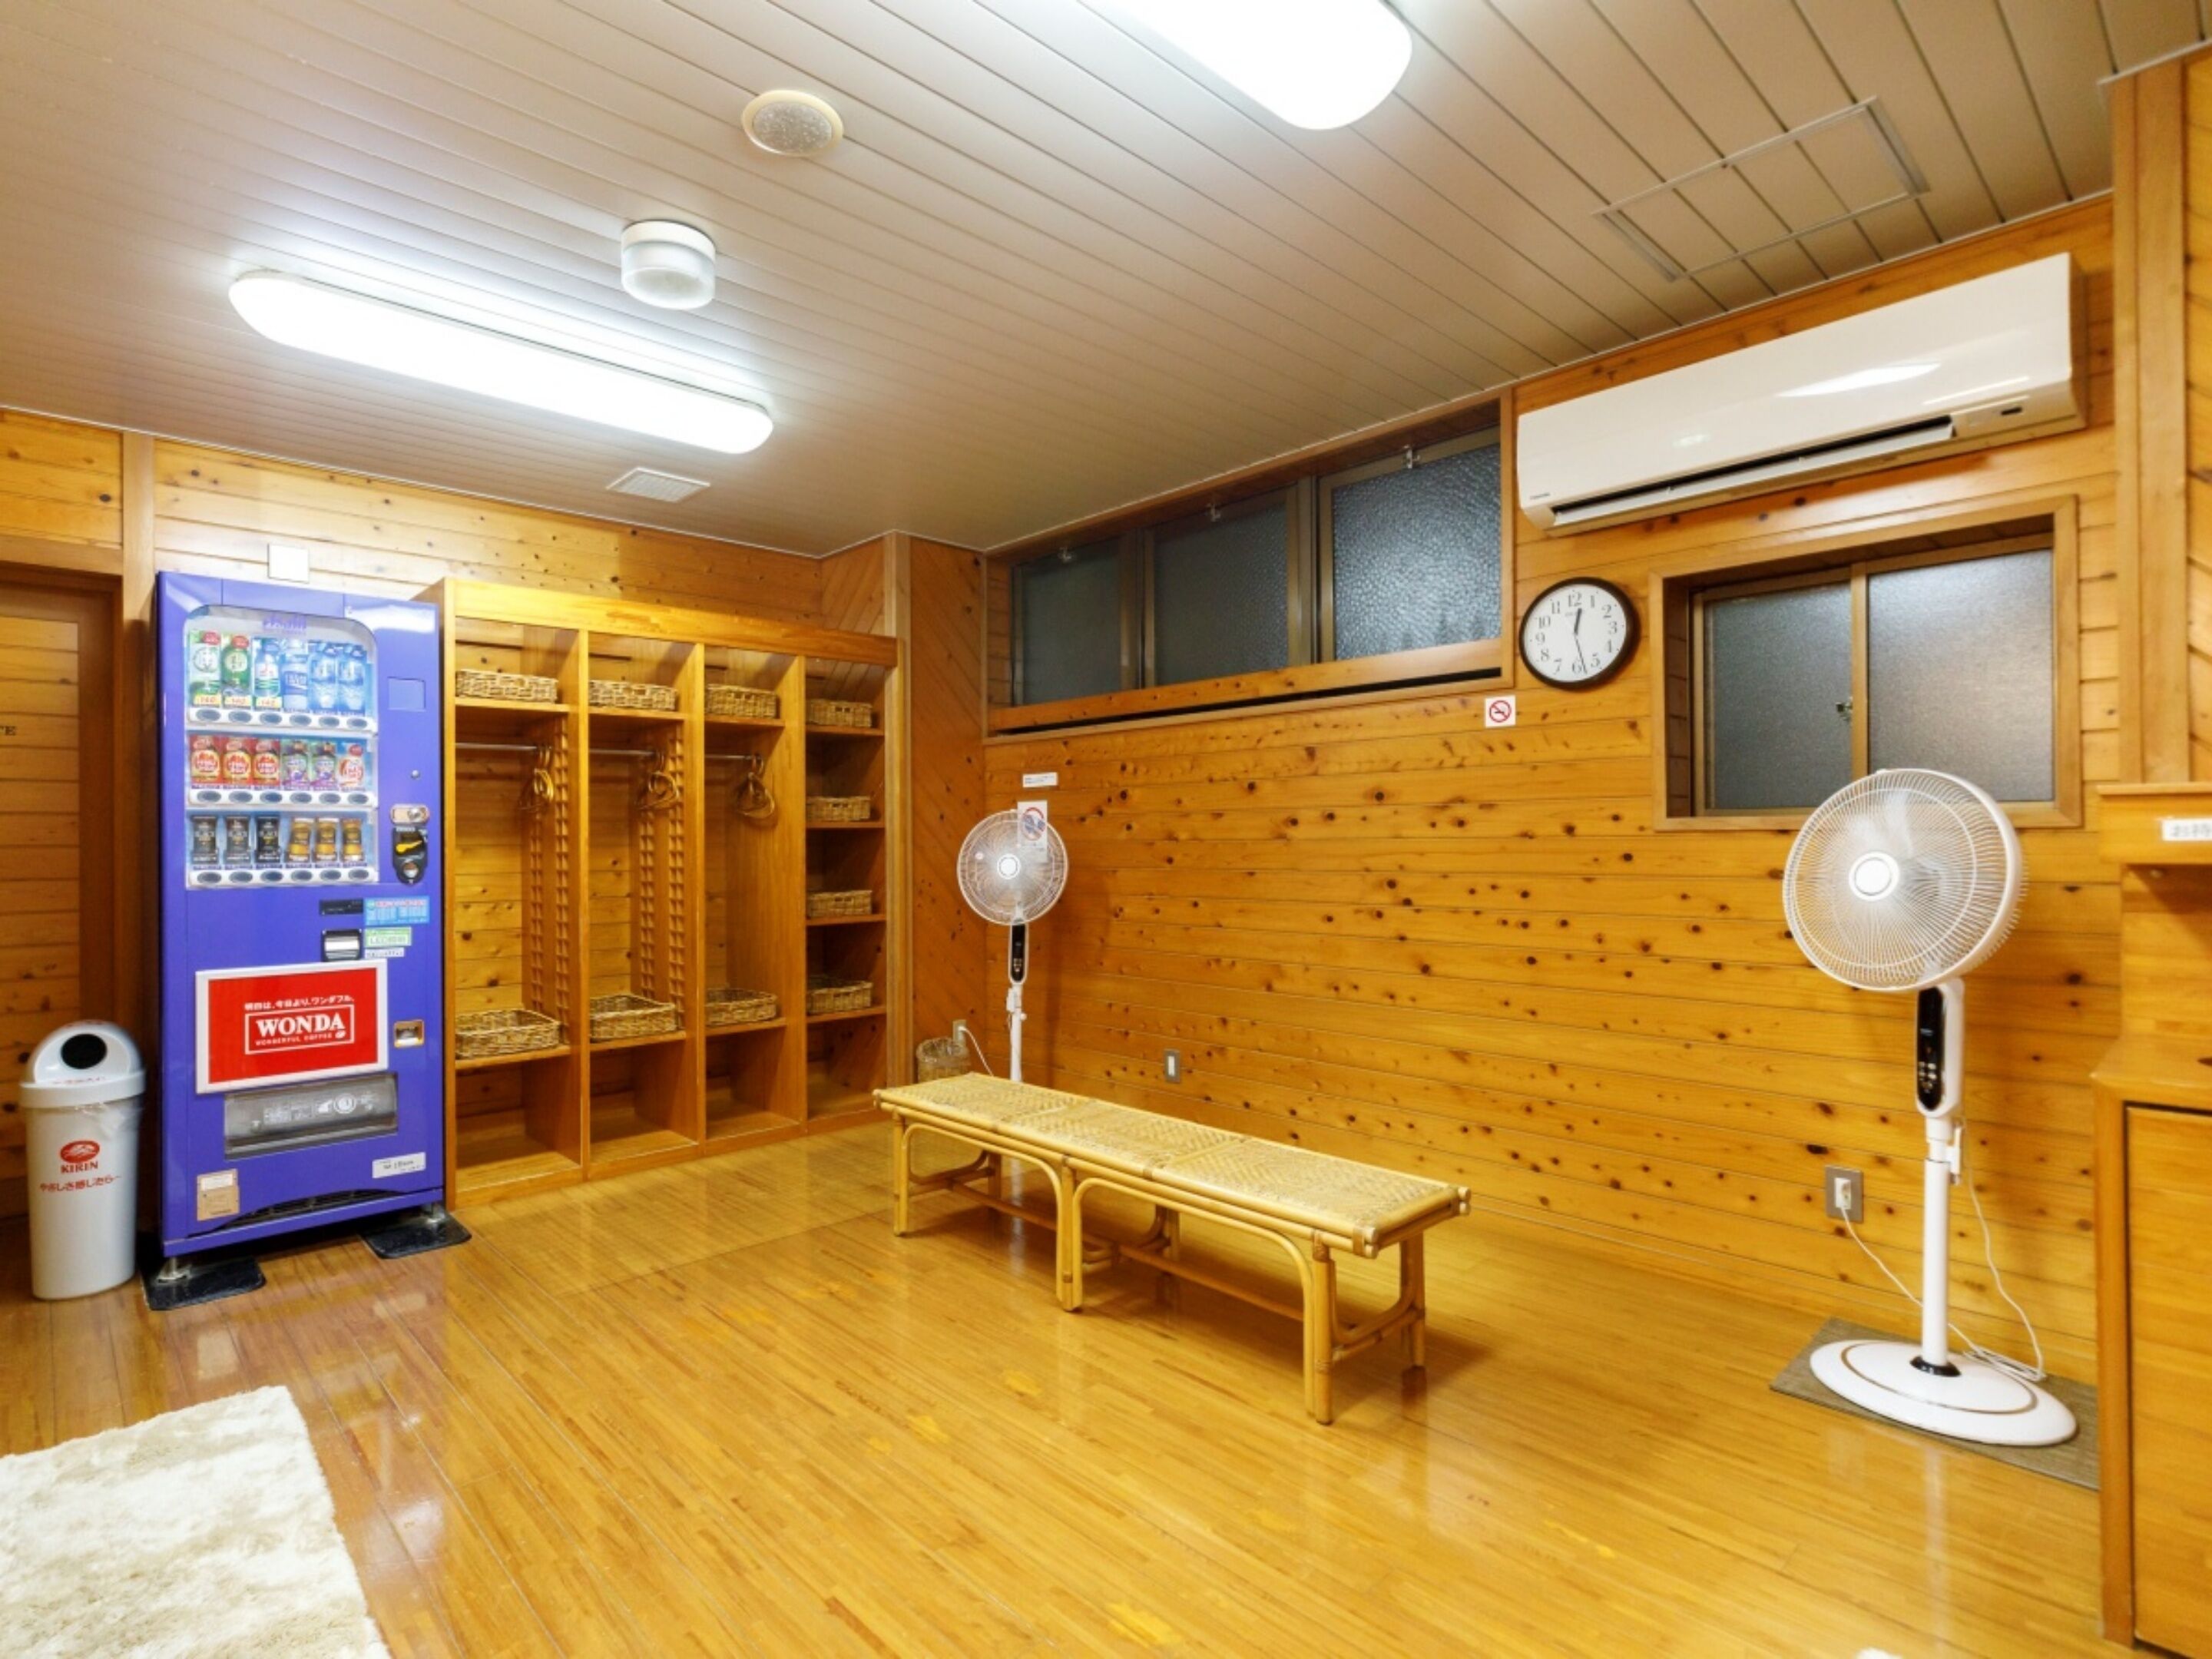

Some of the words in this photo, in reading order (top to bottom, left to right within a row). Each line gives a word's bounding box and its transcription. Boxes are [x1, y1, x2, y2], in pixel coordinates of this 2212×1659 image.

[1568, 591, 1582, 607] 12
[1590, 594, 1595, 608] 1
[1551, 601, 1561, 614] 11
[1601, 604, 1612, 619] 2
[1538, 615, 1551, 628] 10
[1608, 621, 1618, 634] 3
[1535, 632, 1545, 645] 9
[1541, 648, 1550, 661] 8
[1591, 653, 1601, 667] 5
[1553, 658, 1562, 675] 7
[1571, 657, 1583, 674] 6
[256, 1012, 346, 1037] WONDA
[61, 1161, 98, 1174] KIRIN
